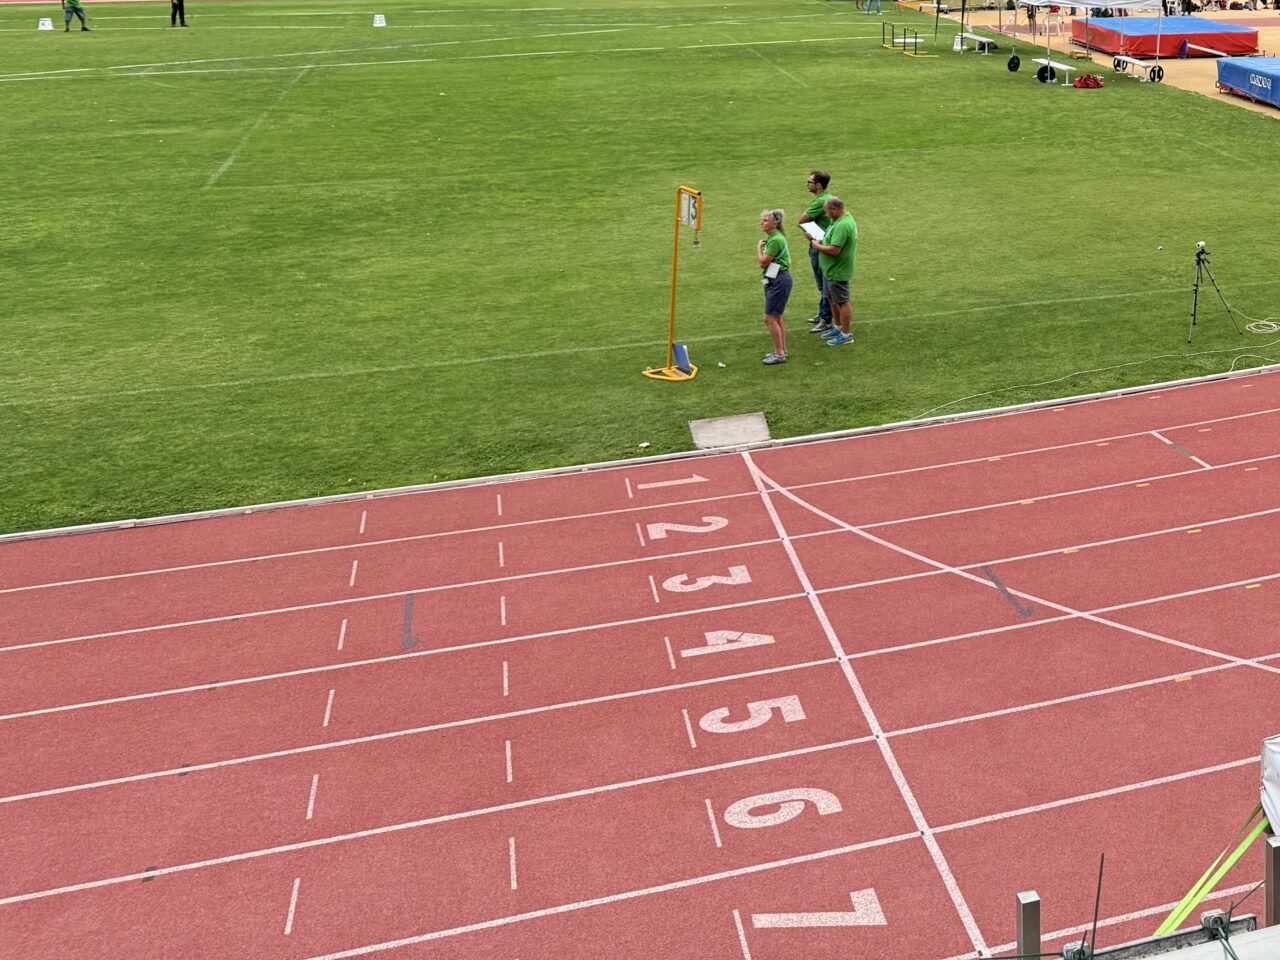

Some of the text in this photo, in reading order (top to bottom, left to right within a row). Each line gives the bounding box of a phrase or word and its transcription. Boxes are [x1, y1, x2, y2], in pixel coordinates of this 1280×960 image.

[637, 473, 711, 490] 1
[646, 515, 729, 540] 2
[662, 564, 753, 593] 3
[680, 629, 776, 658] 4
[698, 694, 807, 734] 5
[723, 787, 844, 829] 6
[751, 887, 888, 929] 7
